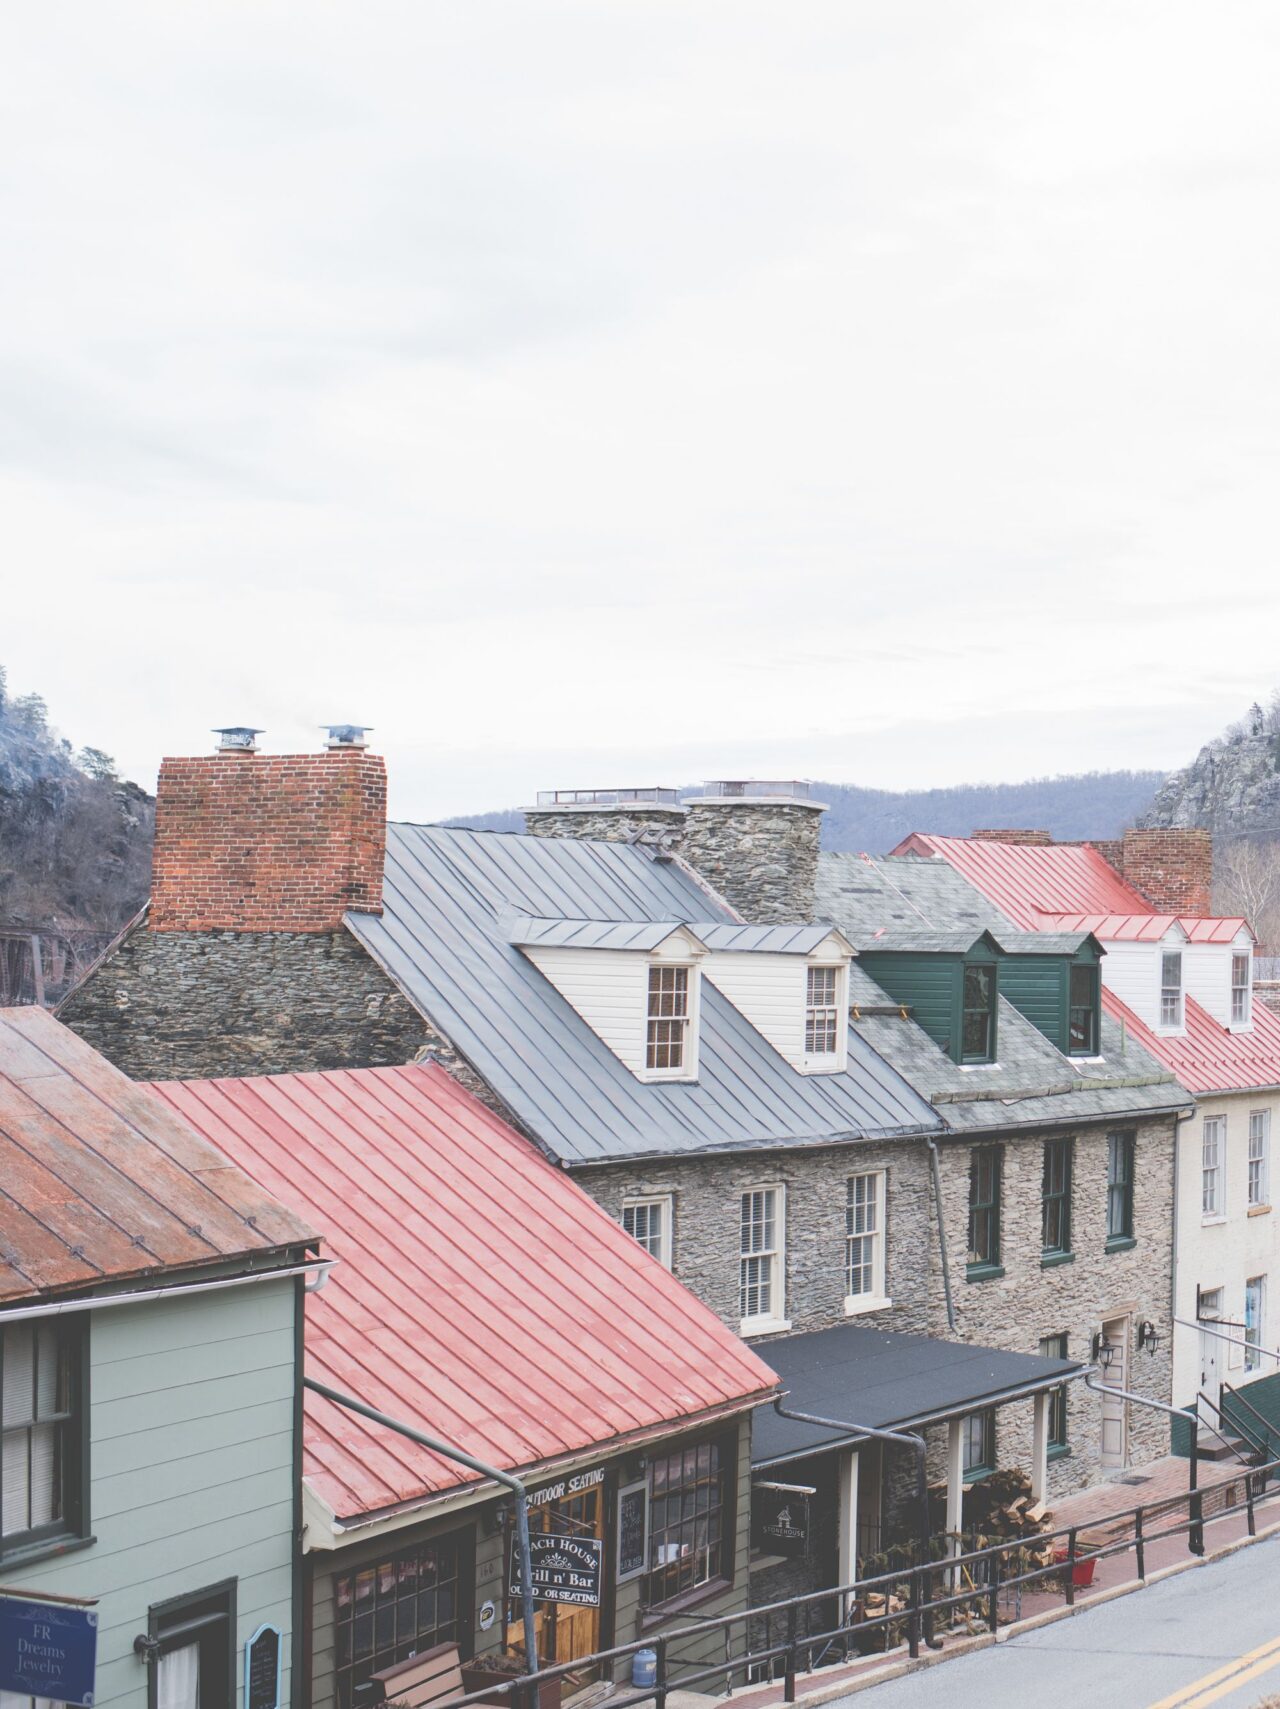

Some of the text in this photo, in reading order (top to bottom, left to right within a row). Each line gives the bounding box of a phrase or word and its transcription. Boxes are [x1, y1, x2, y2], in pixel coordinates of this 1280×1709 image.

[568, 1467, 605, 1494] SEATING
[513, 1538, 599, 1570] CACH HOUSE
[553, 1573, 566, 1584] n'
[569, 1573, 594, 1588] Bar
[559, 1591, 598, 1603] SEATING
[33, 1623, 51, 1640] FR
[18, 1638, 65, 1659] Dreams
[15, 1654, 63, 1675] Jewelry
